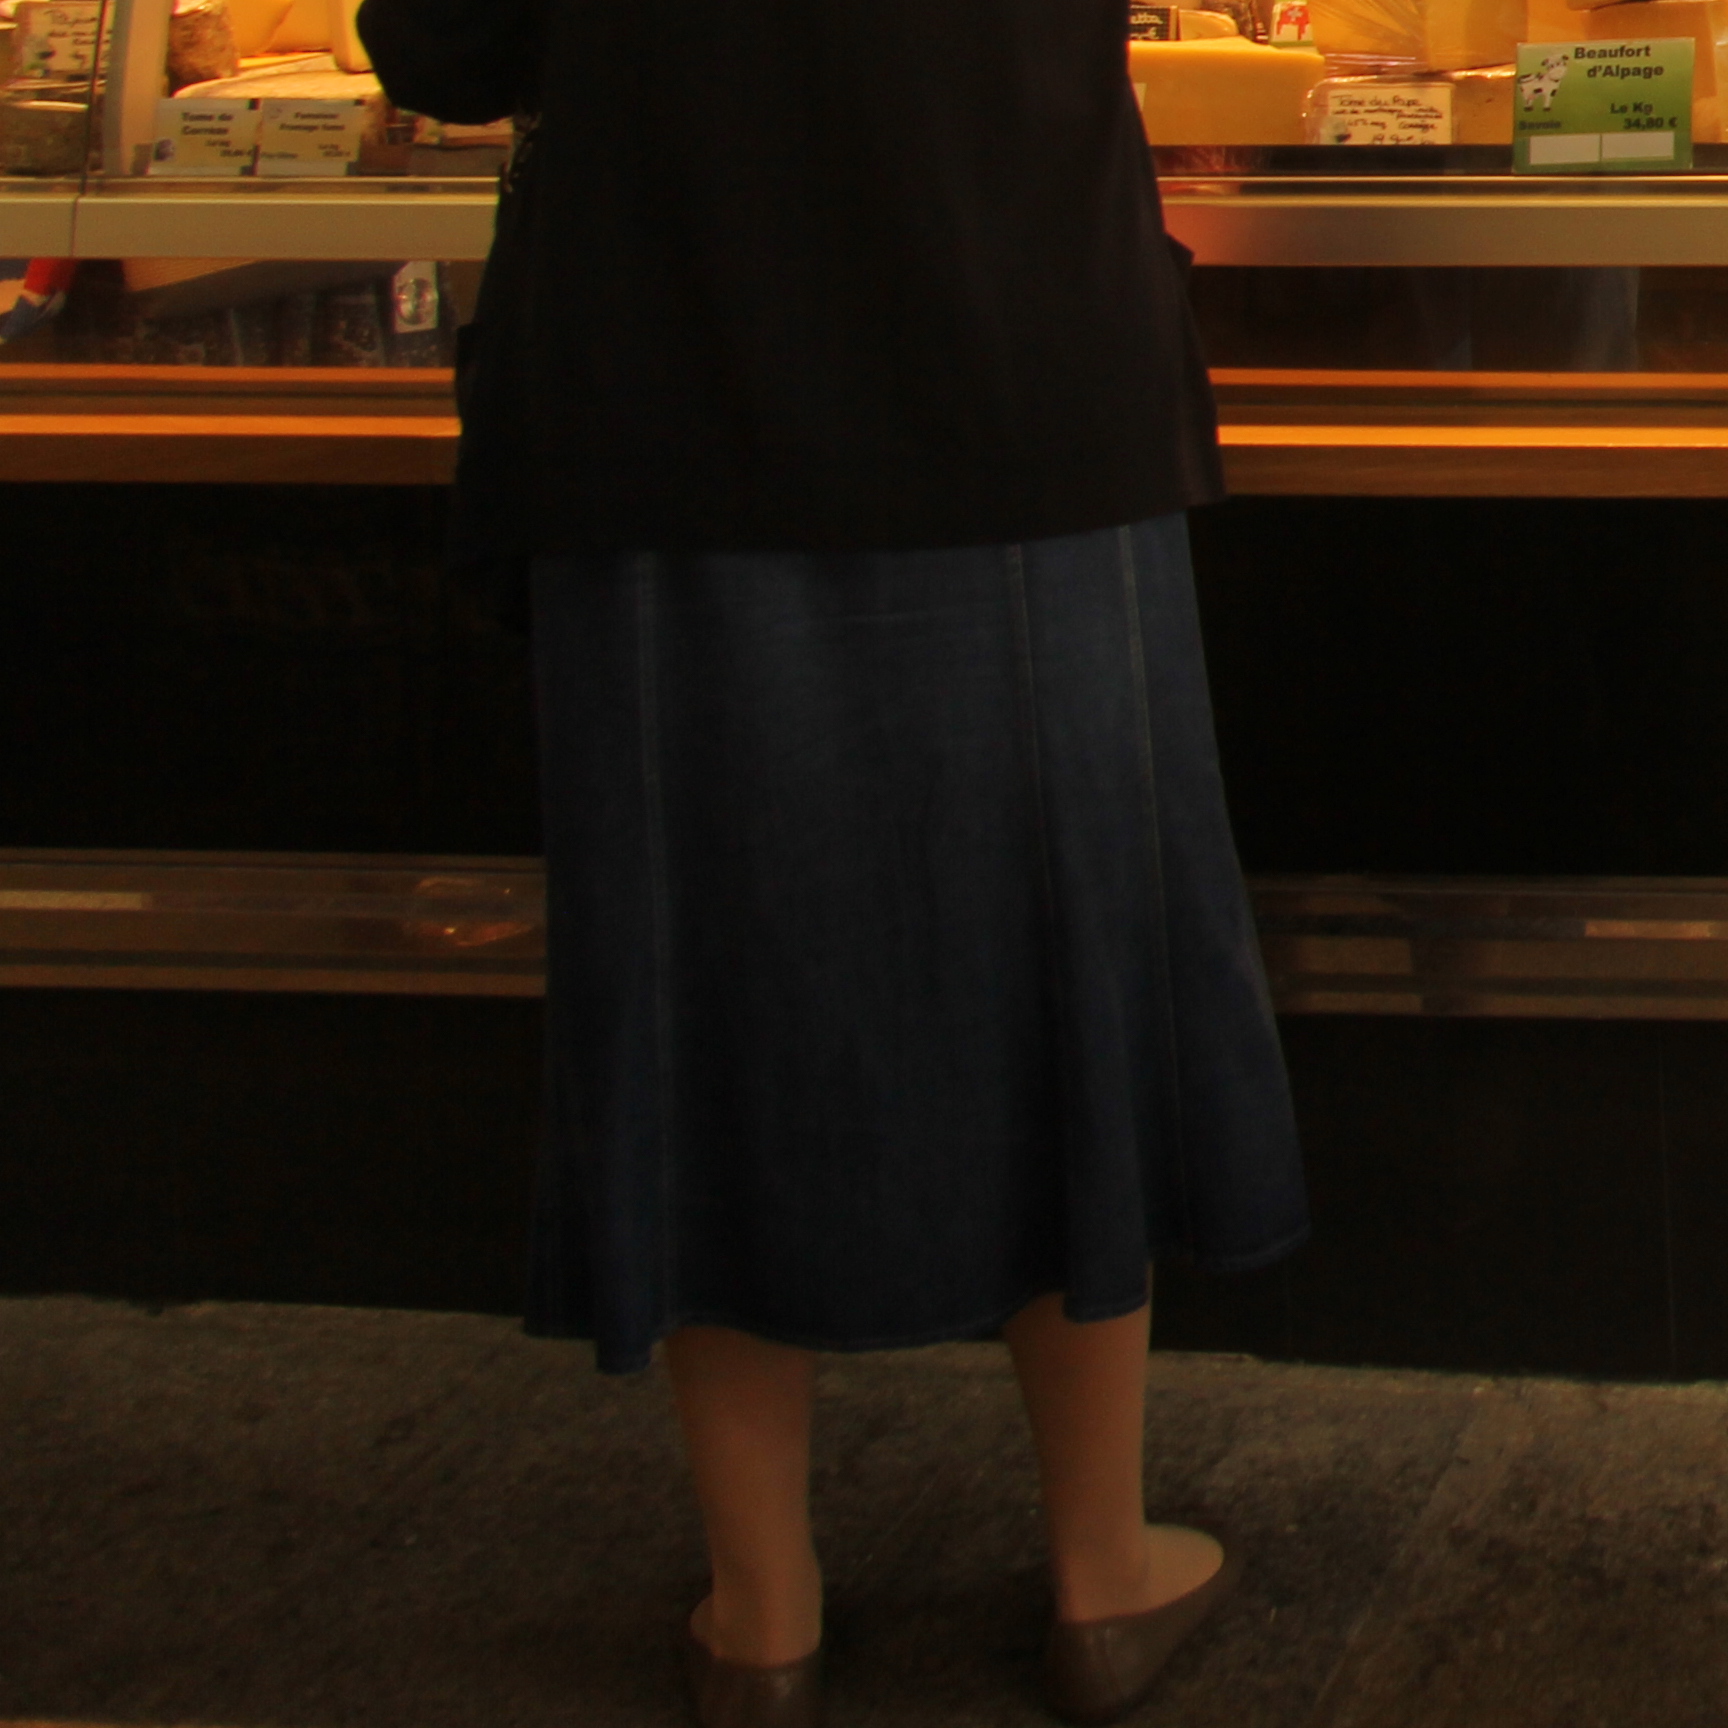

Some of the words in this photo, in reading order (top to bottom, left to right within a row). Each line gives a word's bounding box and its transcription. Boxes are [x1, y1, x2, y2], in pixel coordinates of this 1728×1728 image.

[1574, 44, 1651, 60] Beaufort
[1587, 65, 1664, 79] d'Alpage
[1610, 103, 1628, 114] Le
[1633, 102, 1653, 114] Kg
[1623, 117, 1664, 130] 34,80
[1669, 116, 1677, 128] €
